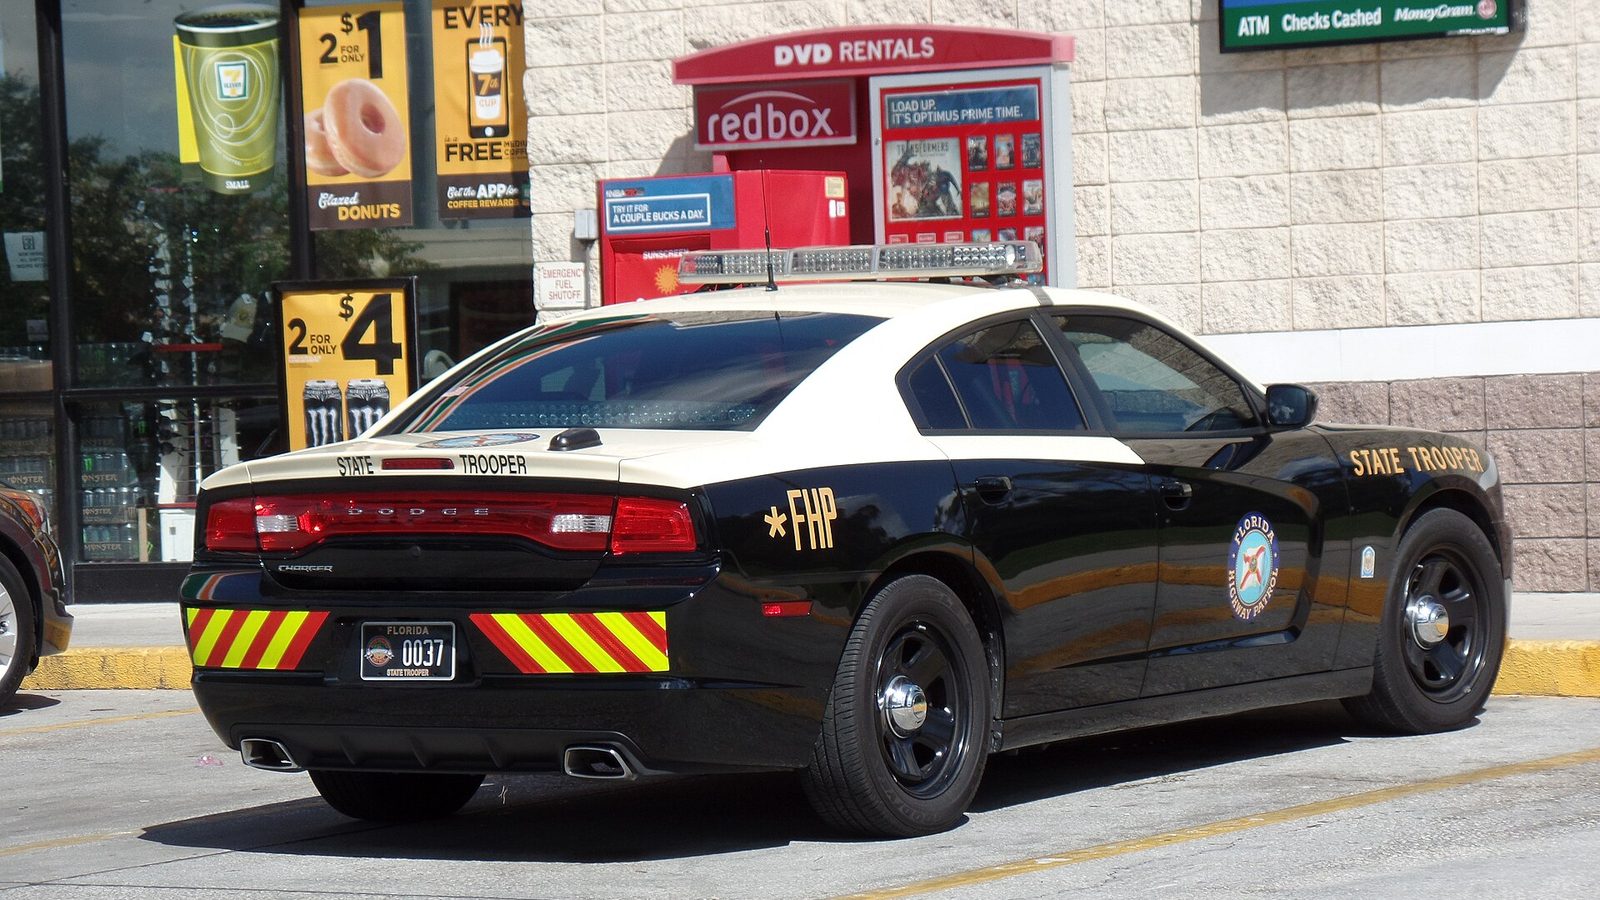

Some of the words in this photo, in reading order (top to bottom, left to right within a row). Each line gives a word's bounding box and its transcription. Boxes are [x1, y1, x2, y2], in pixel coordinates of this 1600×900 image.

[443, 4, 524, 29] EVERY
[1238, 15, 1270, 37] ATM
[1282, 12, 1330, 33] Checks
[1331, 7, 1382, 28] Cashed
[319, 33, 339, 64] 2
[340, 45, 360, 54] FOR
[774, 43, 833, 67] DVD
[839, 37, 935, 63] RENTALS
[340, 54, 365, 63] ONLY
[478, 99, 497, 107] CUP
[891, 101, 919, 113] LOAD
[920, 99, 937, 111] UP.
[892, 112, 911, 125] IT'S
[912, 109, 959, 124] OPTIMUS
[961, 108, 993, 120] PRIME
[994, 105, 1024, 118] TIME.
[708, 103, 835, 142] redbox
[445, 141, 503, 162] FREE
[225, 180, 250, 190] SMALL
[476, 183, 507, 199] APP
[318, 191, 360, 209] Glazed
[447, 200, 479, 209] COFFEE
[338, 203, 401, 221] DONUTS
[612, 205, 626, 213] TRY
[634, 204, 649, 212] FOR
[613, 214, 620, 223] A
[619, 212, 652, 223] COUPLE
[652, 211, 680, 221] BUCKS
[680, 210, 687, 219] A
[643, 249, 689, 260] SUNSCREEN
[543, 268, 585, 279] EMERGENCY
[555, 279, 573, 289] FUEL
[548, 290, 581, 300] SHUTOFF
[288, 317, 308, 355] 2
[310, 334, 330, 344] FOR
[310, 345, 337, 355] ONLY
[336, 455, 374, 476] STATE
[459, 454, 527, 475] TROOPER
[1350, 447, 1404, 476] STATE
[1407, 446, 1484, 473] TROOPER
[348, 508, 488, 516] DODGE
[1234, 515, 1275, 546] FLORIDA
[278, 564, 334, 573] CHARGER
[1228, 569, 1252, 620] HIGHWAY
[1253, 567, 1279, 617] PATROL
[387, 626, 429, 635] FLORIDA
[402, 639, 444, 667] 0037
[386, 668, 404, 677] STATE
[404, 668, 429, 677] TROOPER
